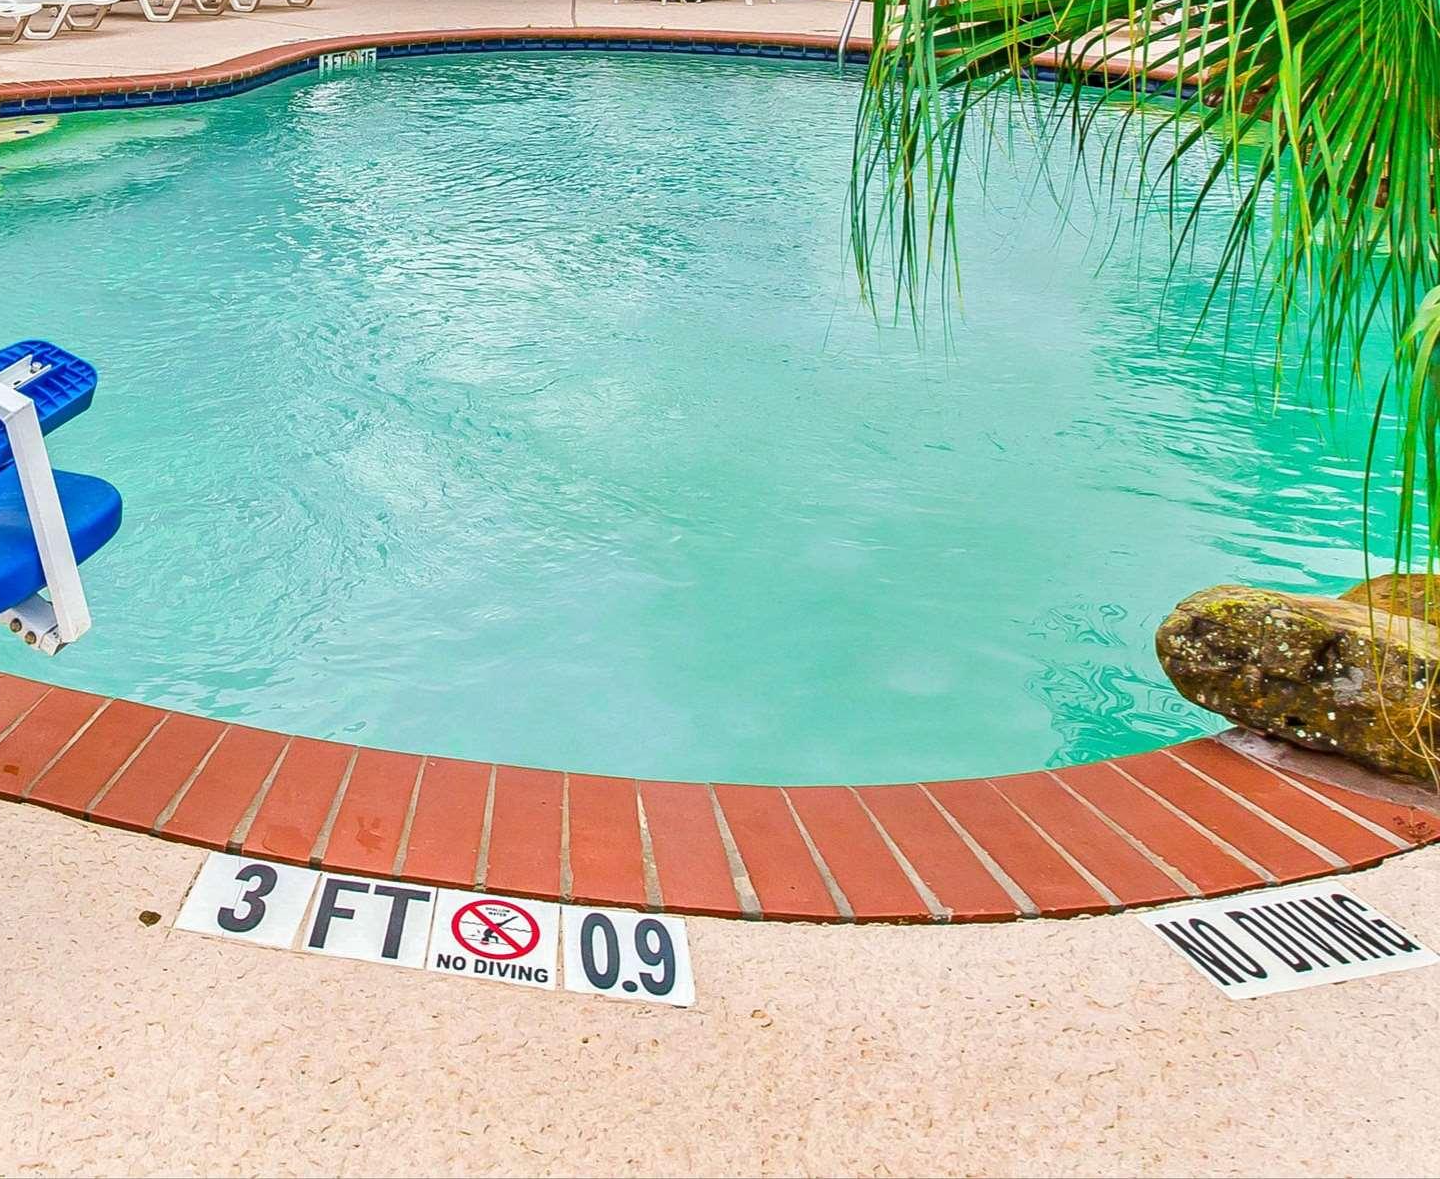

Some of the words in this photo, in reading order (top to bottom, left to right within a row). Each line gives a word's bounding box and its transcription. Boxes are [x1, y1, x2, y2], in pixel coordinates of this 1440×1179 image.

[217, 863, 278, 933] 3
[307, 877, 432, 960] FT
[579, 912, 676, 997] 0.9
[1154, 917, 1269, 986] NO
[1223, 893, 1422, 973] DIVING
[436, 952, 467, 971] NO
[474, 958, 549, 984] DIVING
